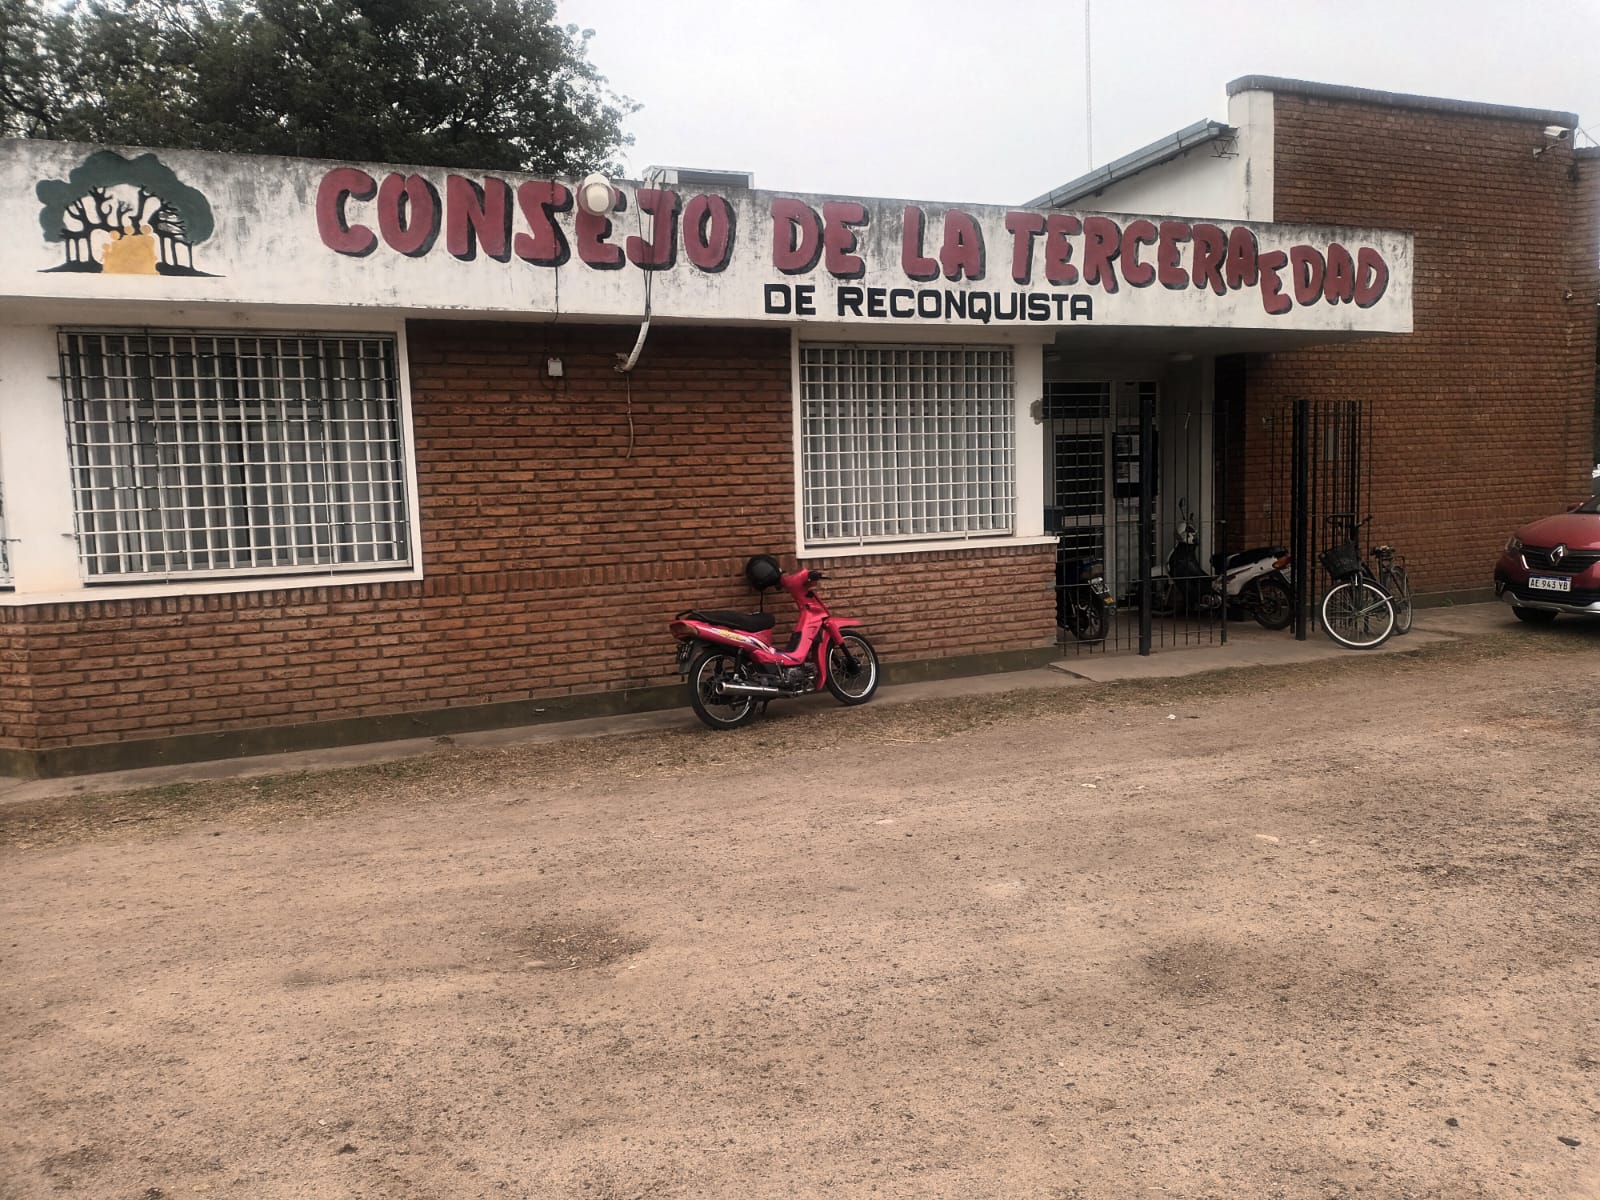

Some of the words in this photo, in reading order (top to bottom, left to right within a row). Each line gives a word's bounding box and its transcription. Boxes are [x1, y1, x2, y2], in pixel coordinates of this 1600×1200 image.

[316, 167, 737, 274] CONSEJO
[771, 197, 869, 280] DE
[901, 204, 986, 281] LA
[1005, 211, 1258, 296] TERCERA
[1258, 243, 1389, 315] EDAD
[764, 283, 816, 316] DE
[837, 286, 1093, 325] RECONQUISTA
[1530, 578, 1539, 588] AE
[1542, 579, 1556, 589] 943
[1559, 580, 1568, 590] YB
